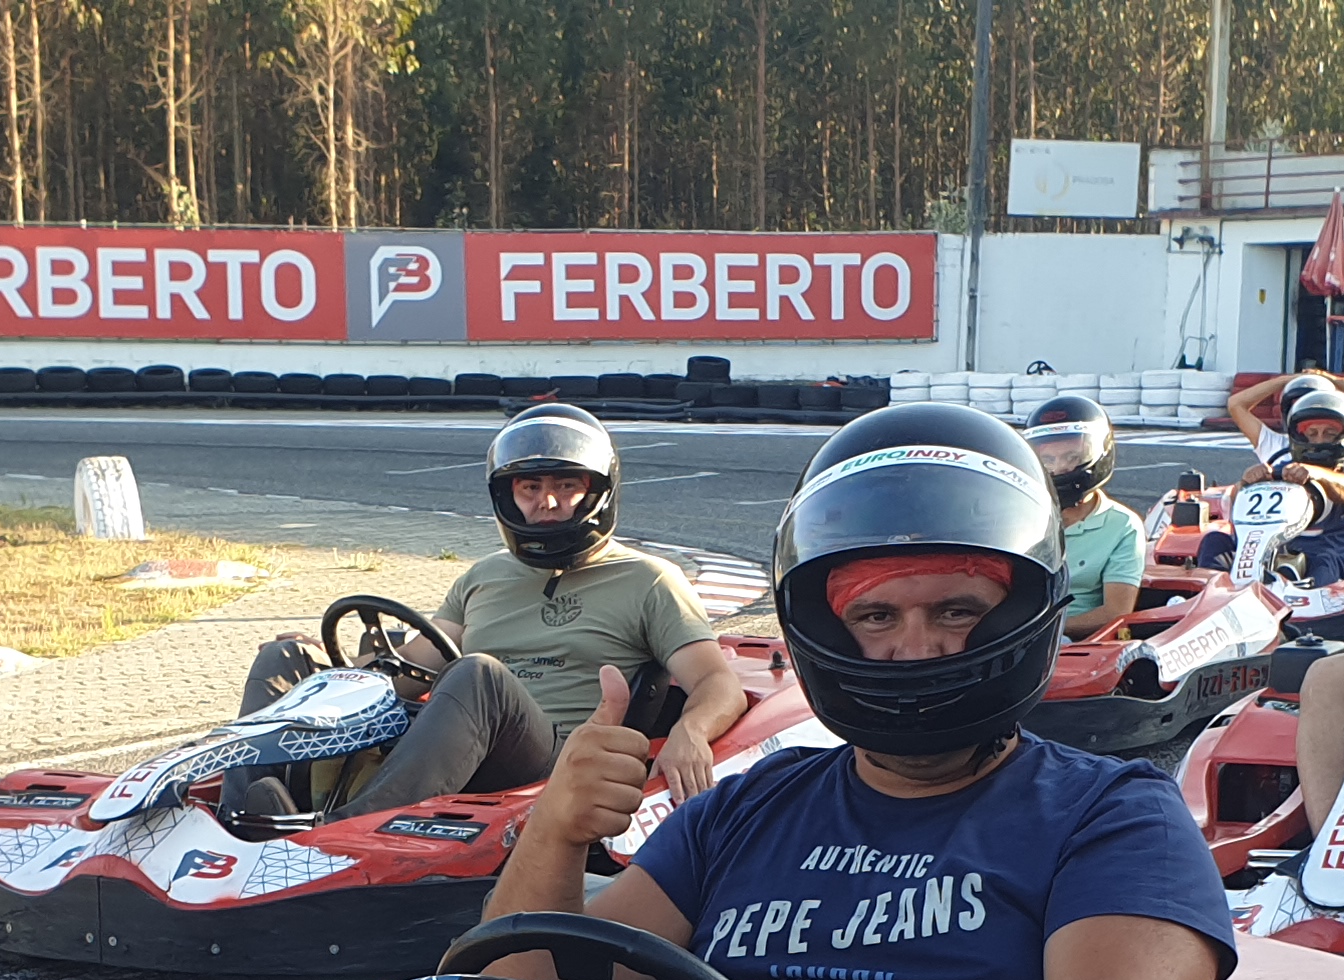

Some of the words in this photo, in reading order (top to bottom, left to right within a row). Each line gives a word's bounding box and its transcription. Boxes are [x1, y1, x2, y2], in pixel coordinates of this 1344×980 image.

[500, 252, 911, 322] FERBERTO
[839, 449, 968, 473] EUROINDY
[1246, 491, 1283, 516] 22
[1236, 529, 1265, 579] FERBERTO
[1159, 626, 1230, 675] ERBERTO
[274, 680, 328, 716] 3
[388, 819, 481, 840] PALOCAR
[799, 844, 935, 879] AUTHENTIC
[704, 899, 822, 962] PEPE
[831, 872, 987, 949] JEANS
